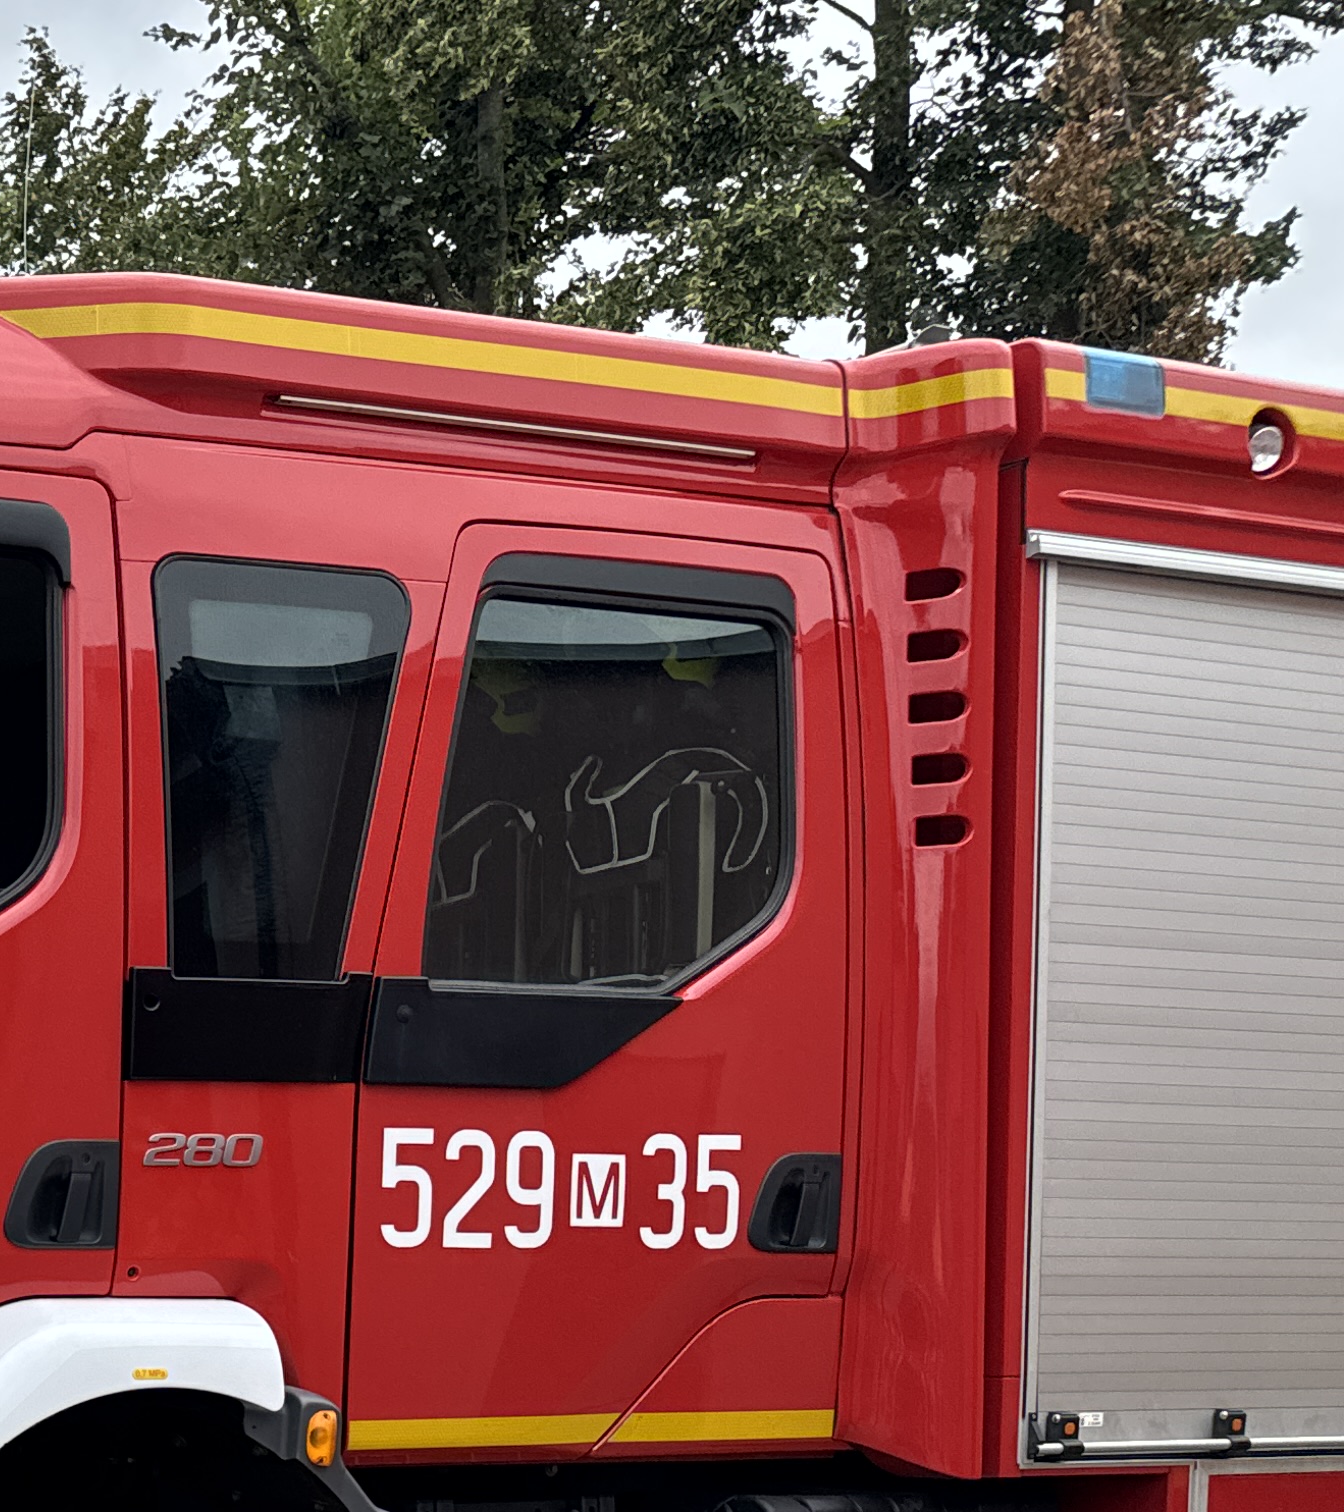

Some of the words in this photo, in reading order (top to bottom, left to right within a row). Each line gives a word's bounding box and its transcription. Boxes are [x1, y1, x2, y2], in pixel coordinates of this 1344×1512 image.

[143, 1132, 264, 1167] 280
[380, 1127, 558, 1248] 529
[574, 1159, 621, 1221] M
[639, 1132, 742, 1250] 35
